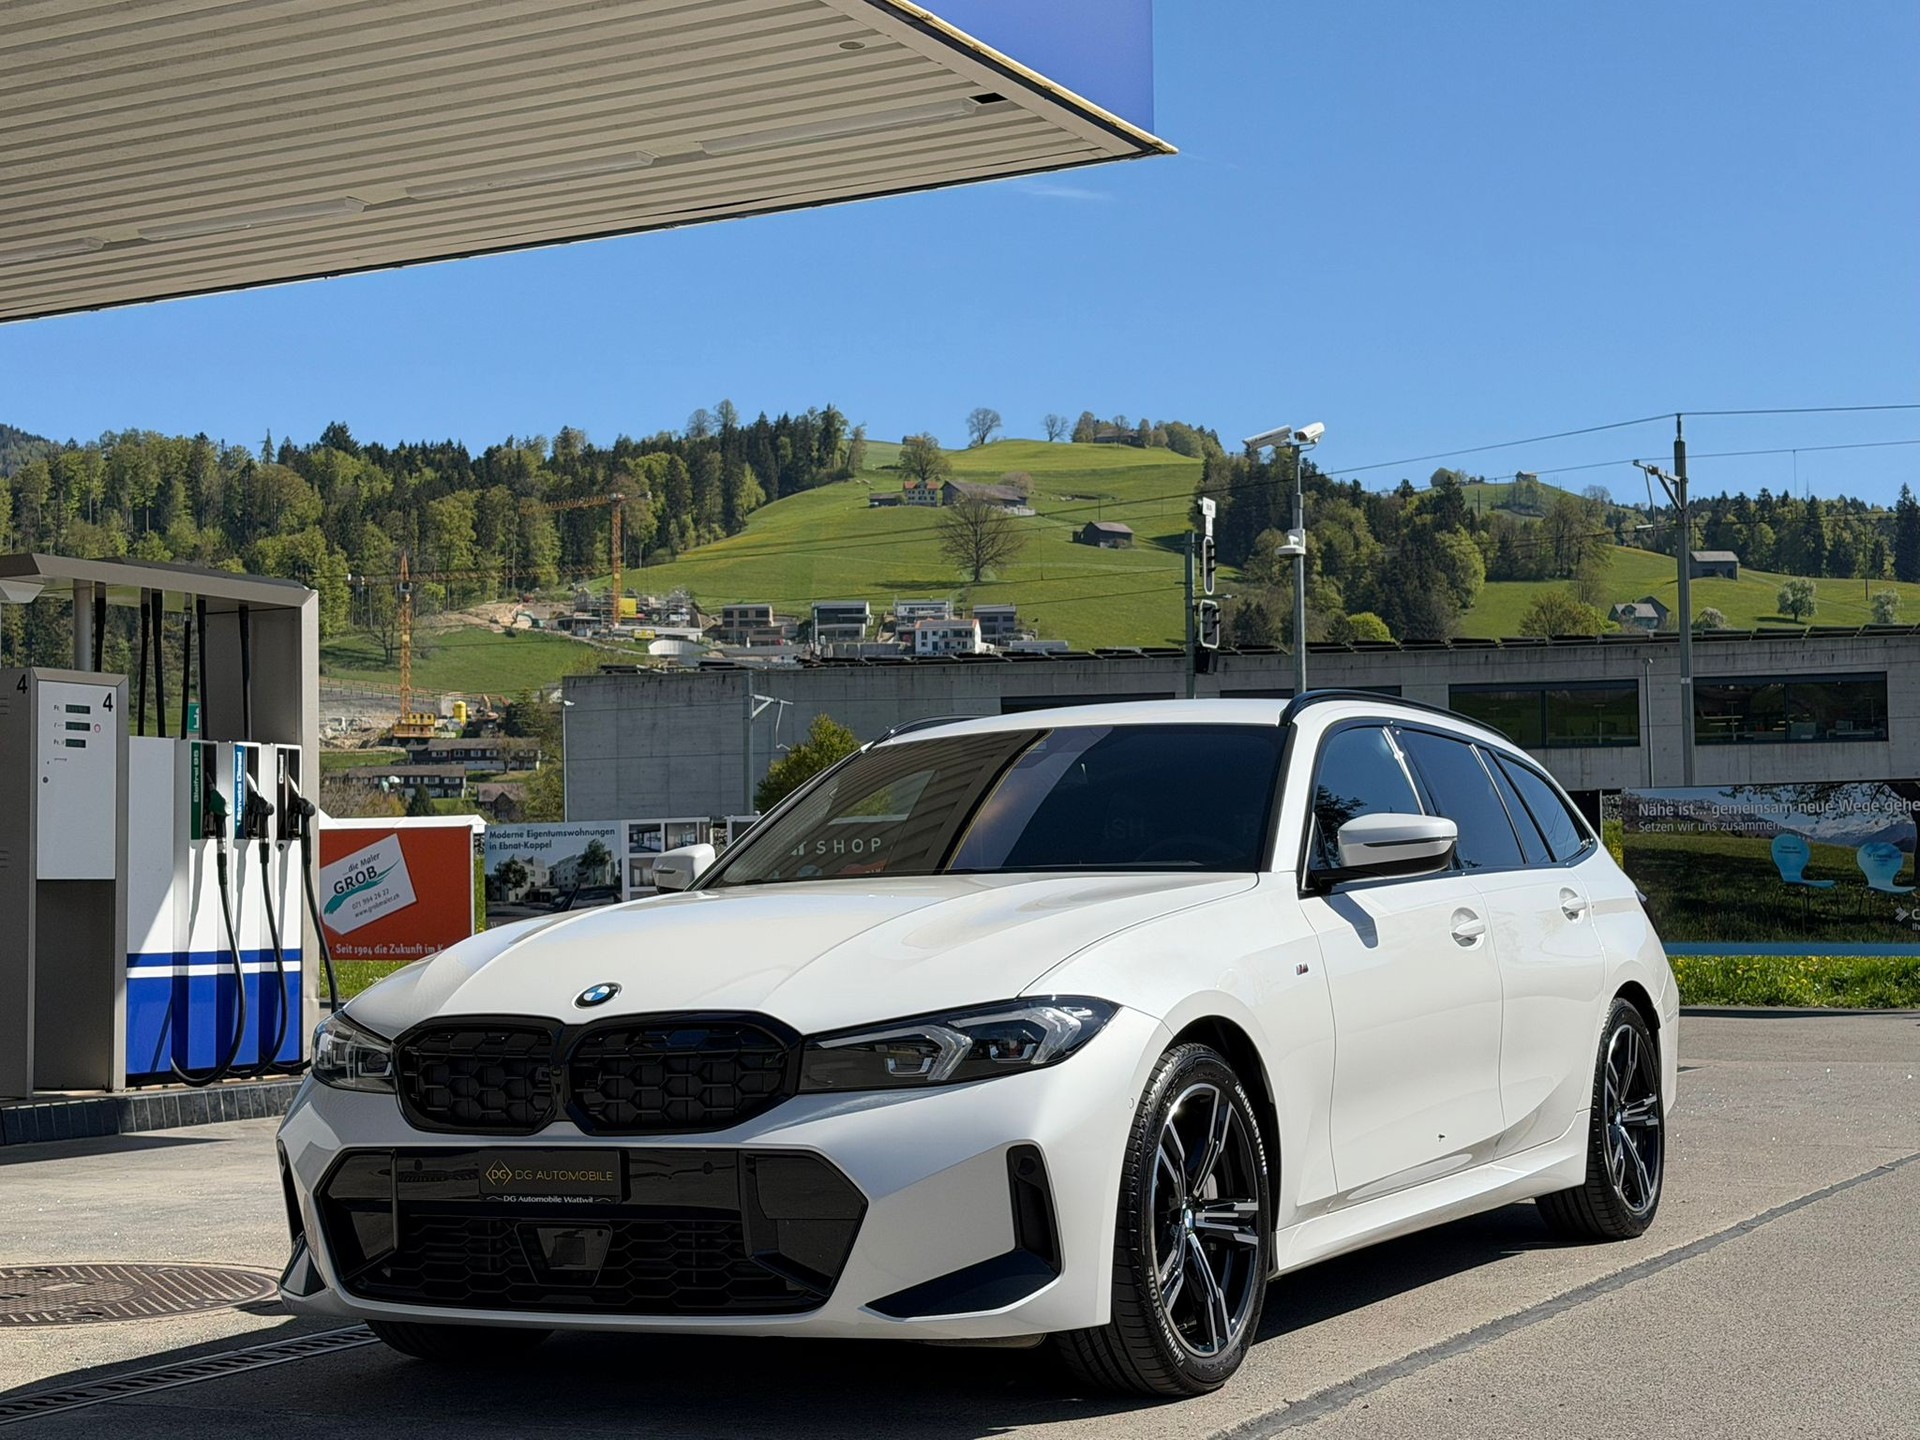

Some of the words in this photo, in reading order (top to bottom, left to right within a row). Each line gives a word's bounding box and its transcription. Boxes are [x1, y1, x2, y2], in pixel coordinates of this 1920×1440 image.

[16, 673, 28, 694] 4
[102, 692, 113, 712] 4
[1638, 802, 1674, 816] Nähe
[1678, 802, 1707, 816] ist...
[1711, 801, 1793, 818] gemeinsam
[1798, 802, 1833, 813] neue
[1839, 799, 1882, 815] Wege
[488, 829, 525, 840] Moderne
[527, 828, 615, 840] Eigentumswohnungen
[1638, 821, 1674, 833] Setzen
[1677, 820, 1694, 832] wir
[1698, 822, 1717, 832] uns
[488, 841, 497, 850] in
[499, 840, 552, 852] Ebnat-Kappel
[816, 837, 882, 854] SHOP
[360, 852, 380, 867] Maler
[333, 865, 377, 895] GROB
[336, 943, 353, 954] Seit
[353, 944, 372, 957] 1904
[374, 943, 386, 954] die
[389, 943, 423, 954] Zukunft
[424, 943, 435, 954] im
[1234, 1081, 1268, 1175] BRIDGESTONE
[491, 1169, 507, 1180] DG
[515, 1170, 533, 1180] DG
[535, 1171, 614, 1182] AUTOMOBILE
[503, 1195, 517, 1203] DG
[518, 1195, 562, 1204] Automobile
[563, 1196, 593, 1204] Wattwil
[1147, 1266, 1186, 1368] BRIDGESTONE
